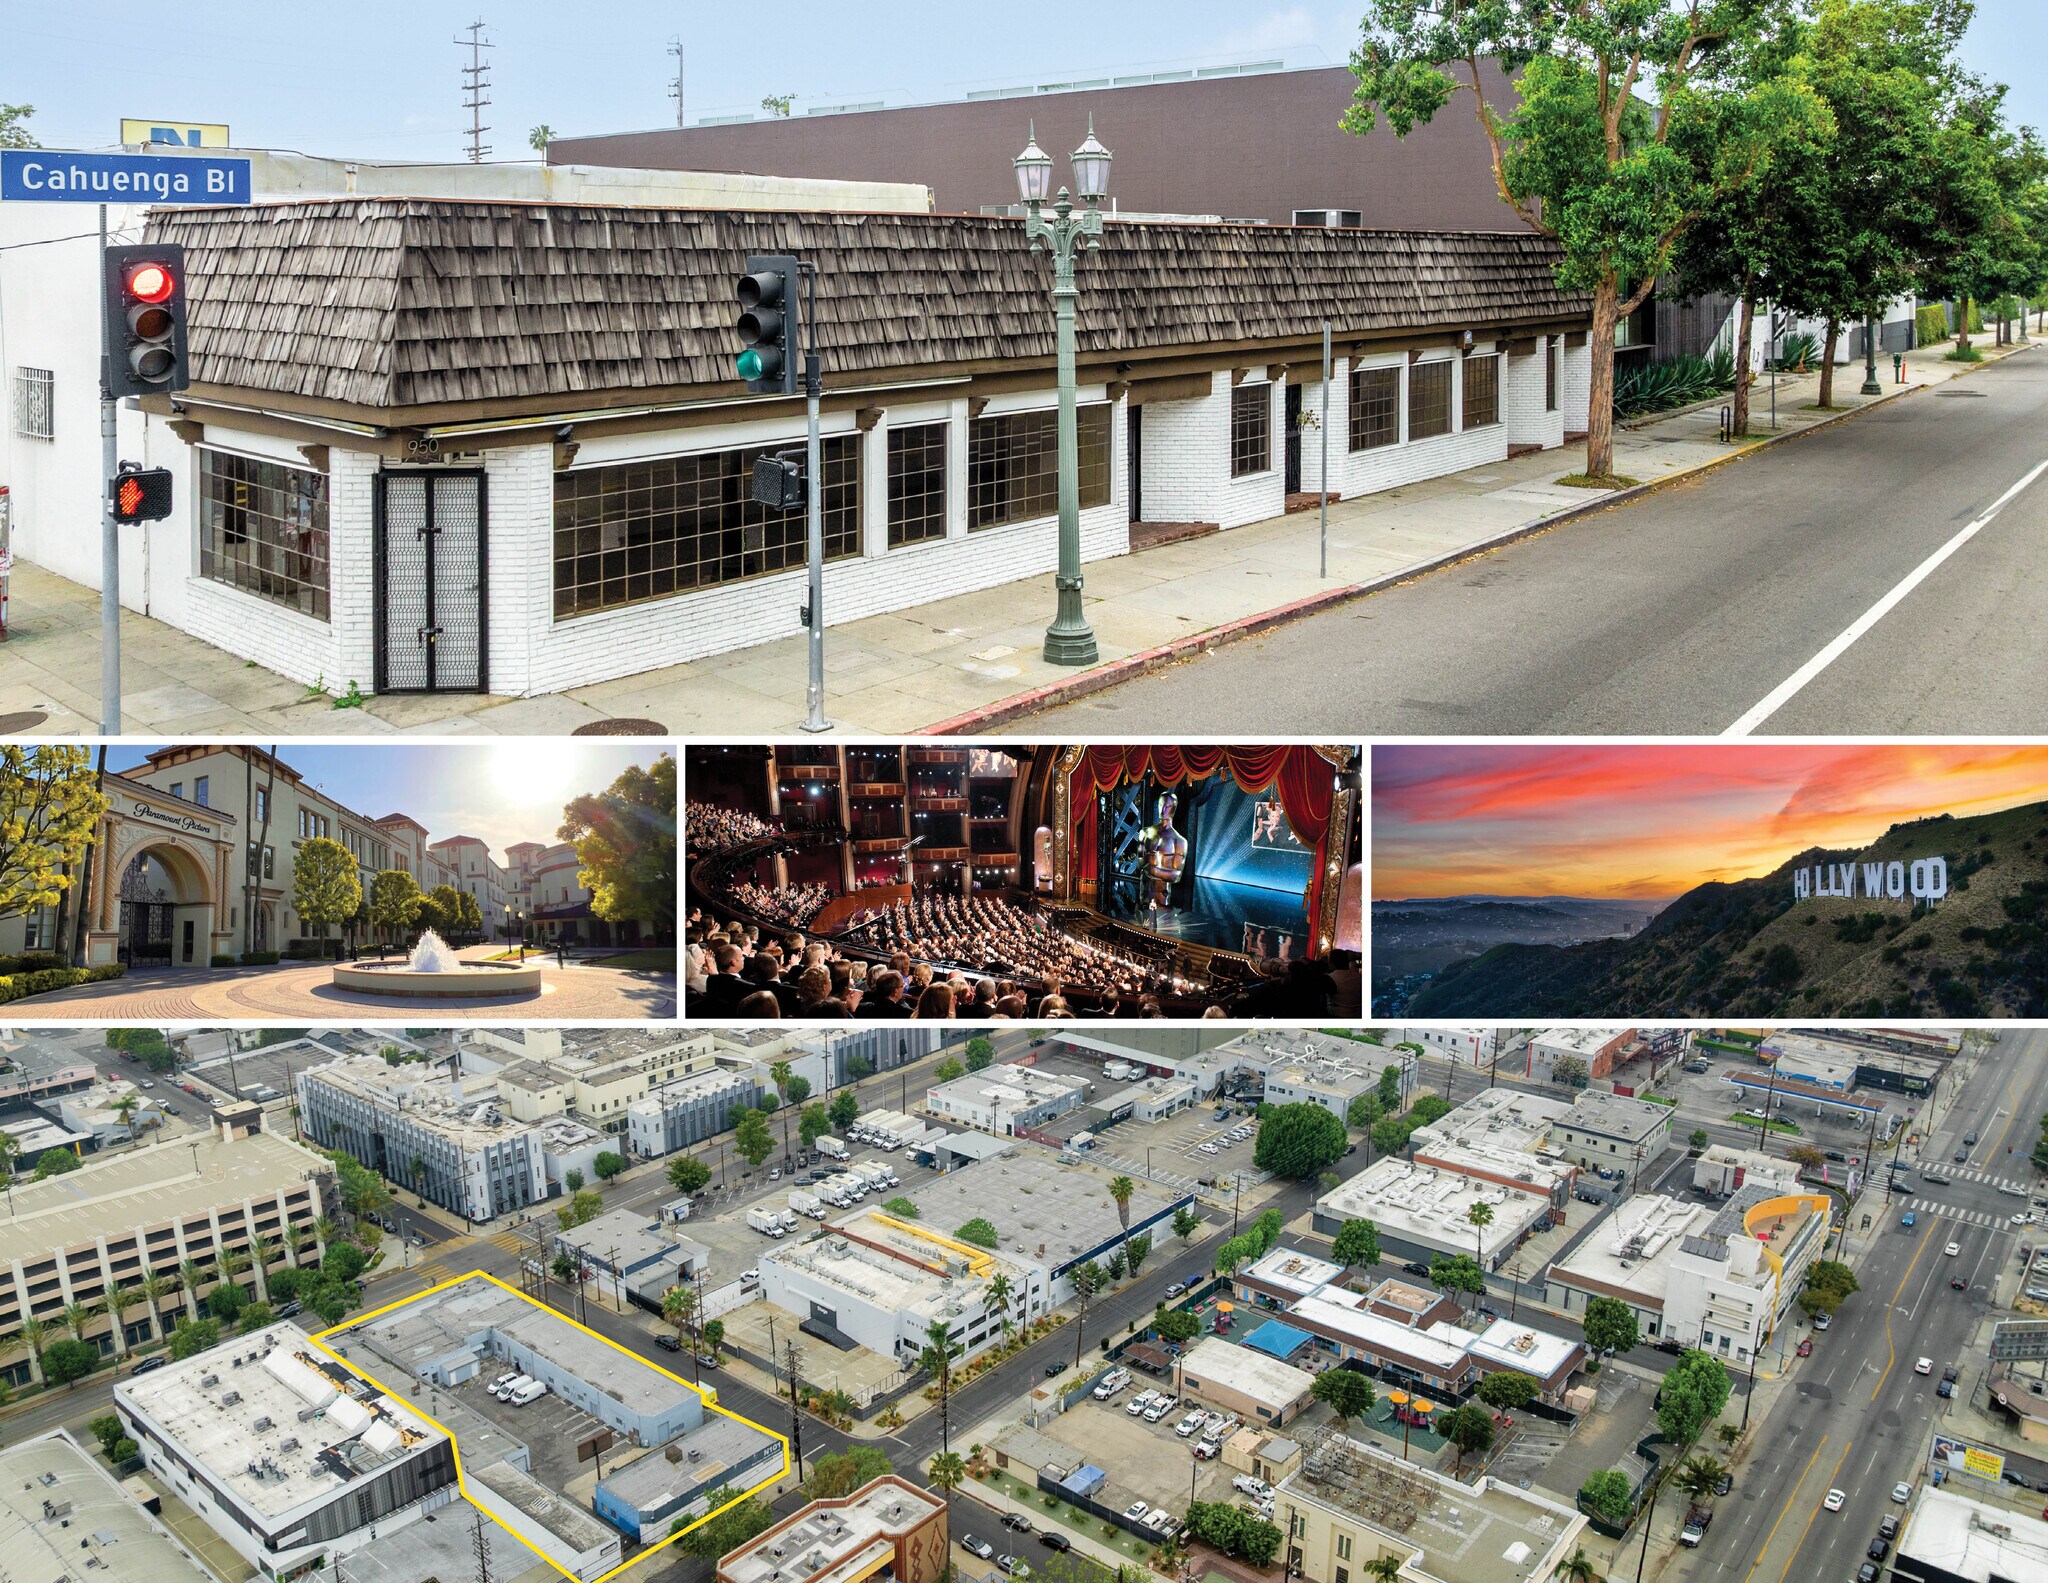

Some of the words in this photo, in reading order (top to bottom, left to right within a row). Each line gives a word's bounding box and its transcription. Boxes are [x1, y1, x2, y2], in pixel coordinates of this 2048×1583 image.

[22, 163, 189, 200] Cahuenga
[207, 168, 234, 193] Bl
[407, 438, 439, 455] 950
[133, 803, 182, 825] Paramount
[181, 816, 210, 833] Pictures
[1794, 856, 1947, 899] HOLLYWOOD
